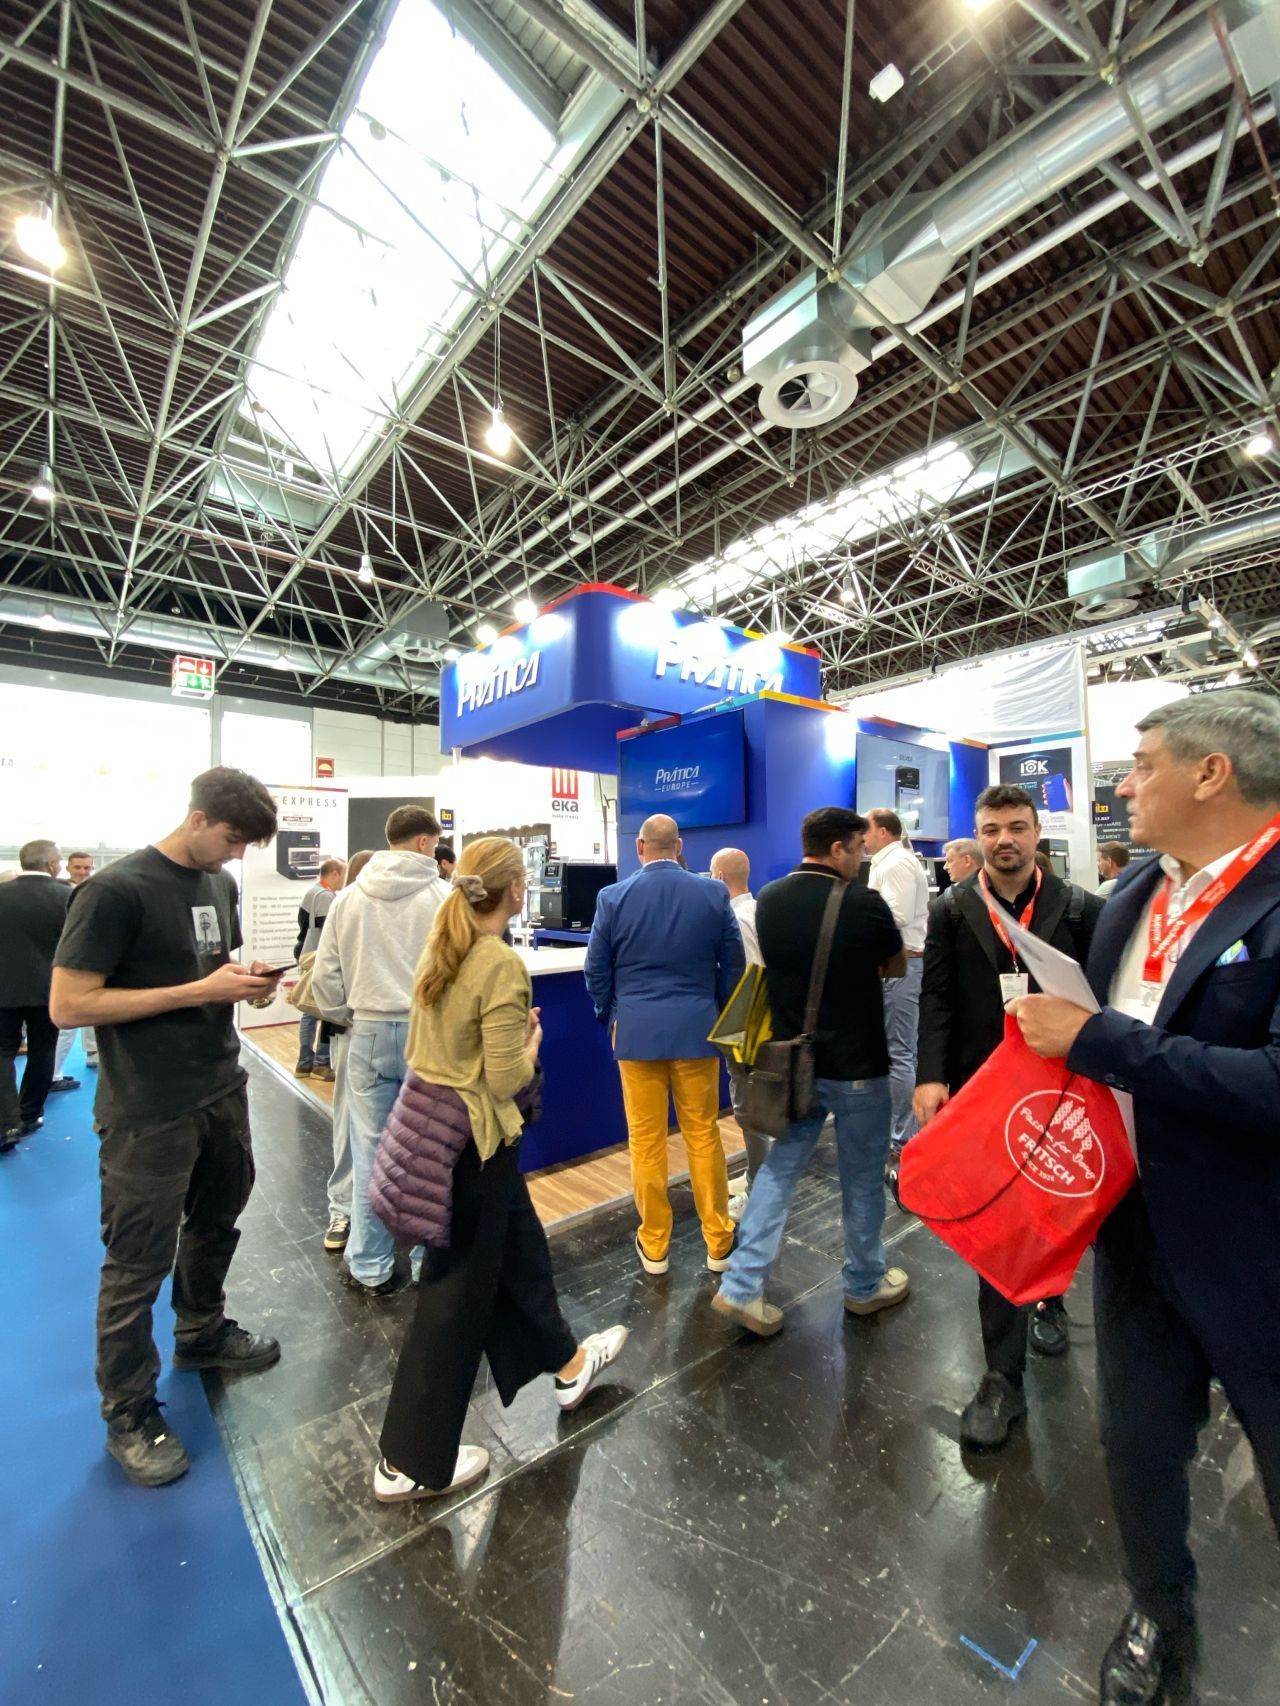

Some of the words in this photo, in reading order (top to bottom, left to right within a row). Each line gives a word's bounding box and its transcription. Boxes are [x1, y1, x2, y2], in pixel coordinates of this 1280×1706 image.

[661, 780, 691, 793] EUROPE
[282, 795, 337, 808] EXPRESS
[551, 799, 579, 813] eka
[1052, 1140, 1072, 1154] for
[1017, 1132, 1076, 1186] FRITSCH
